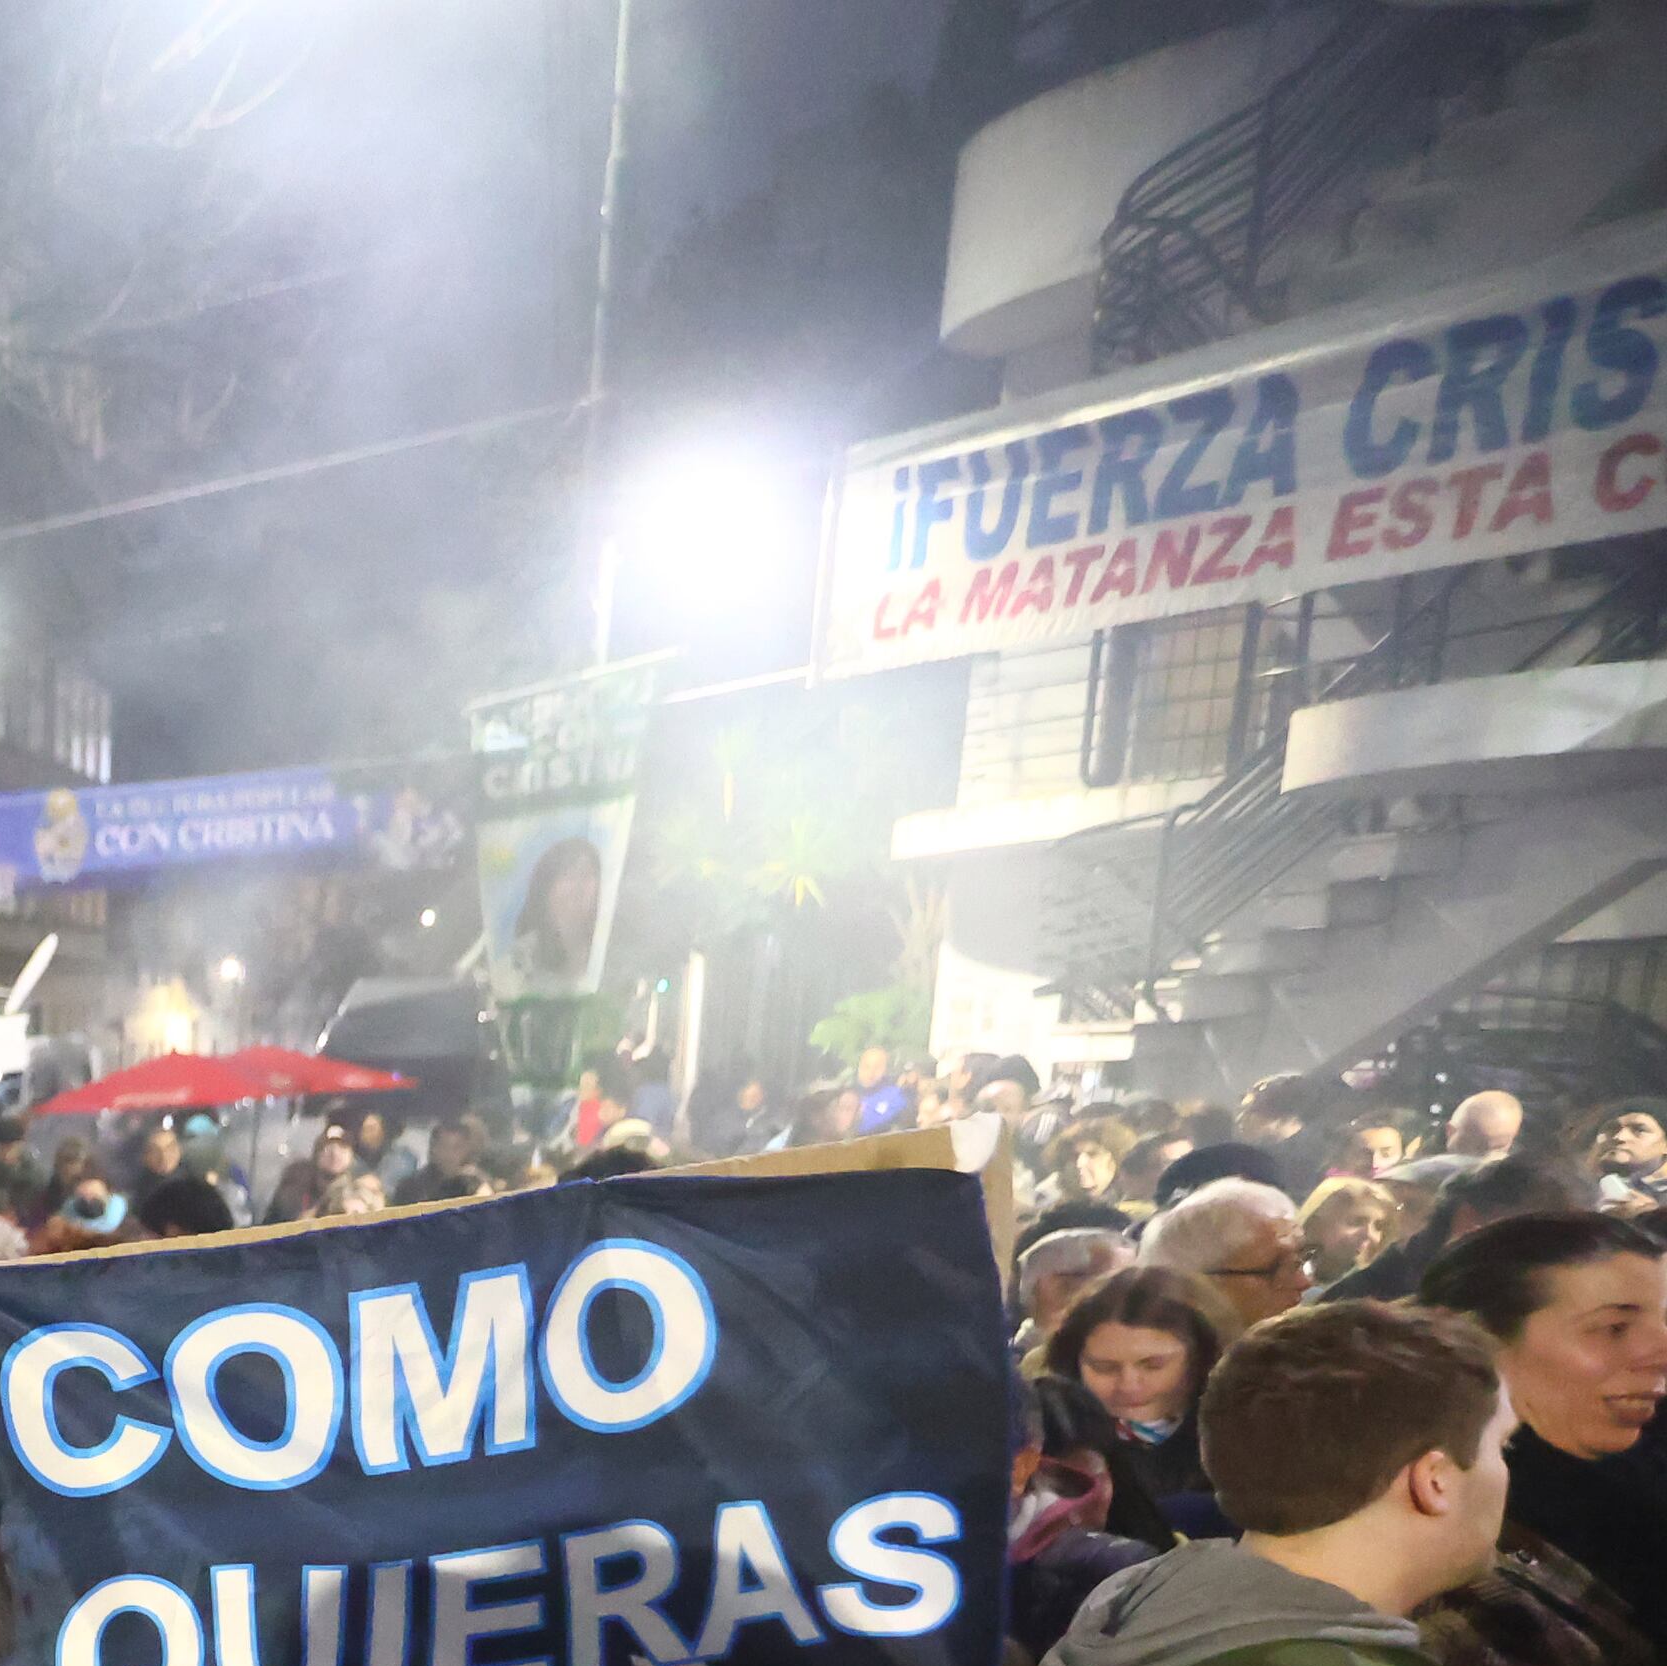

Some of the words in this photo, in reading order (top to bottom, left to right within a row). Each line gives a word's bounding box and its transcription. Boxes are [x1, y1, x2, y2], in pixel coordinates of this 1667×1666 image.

[872, 578, 942, 641] LA
[958, 505, 1296, 625] MATANZA
[1324, 452, 1555, 562] ESTA
[94, 821, 170, 859] CON
[0, 1237, 716, 1497] COMO
